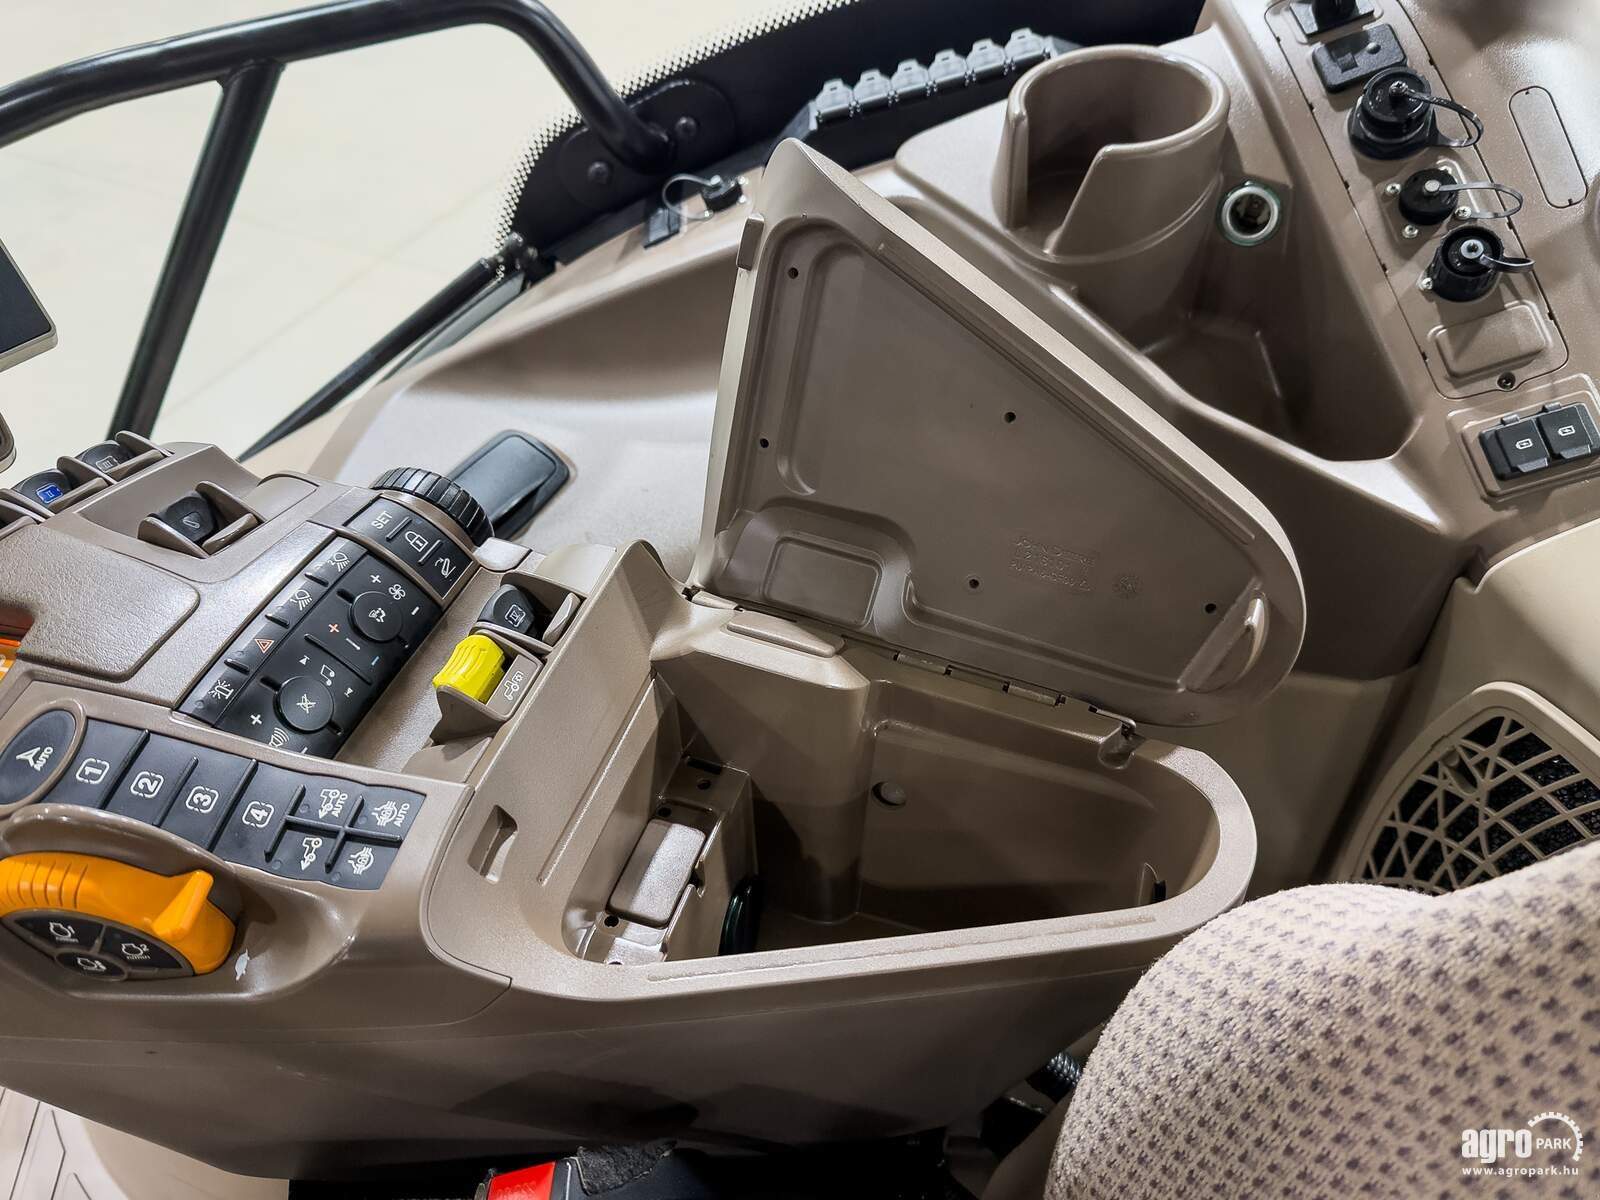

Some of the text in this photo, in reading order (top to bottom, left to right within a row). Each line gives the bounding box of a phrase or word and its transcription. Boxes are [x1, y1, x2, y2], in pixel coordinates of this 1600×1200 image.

[371, 511, 392, 529] SET
[34, 747, 53, 771] AUTO
[84, 766, 102, 775] 1
[138, 778, 158, 792] 2
[193, 793, 211, 806] 3
[331, 793, 348, 817] AUTO
[250, 808, 268, 821] 4
[394, 803, 410, 826] AUTO
